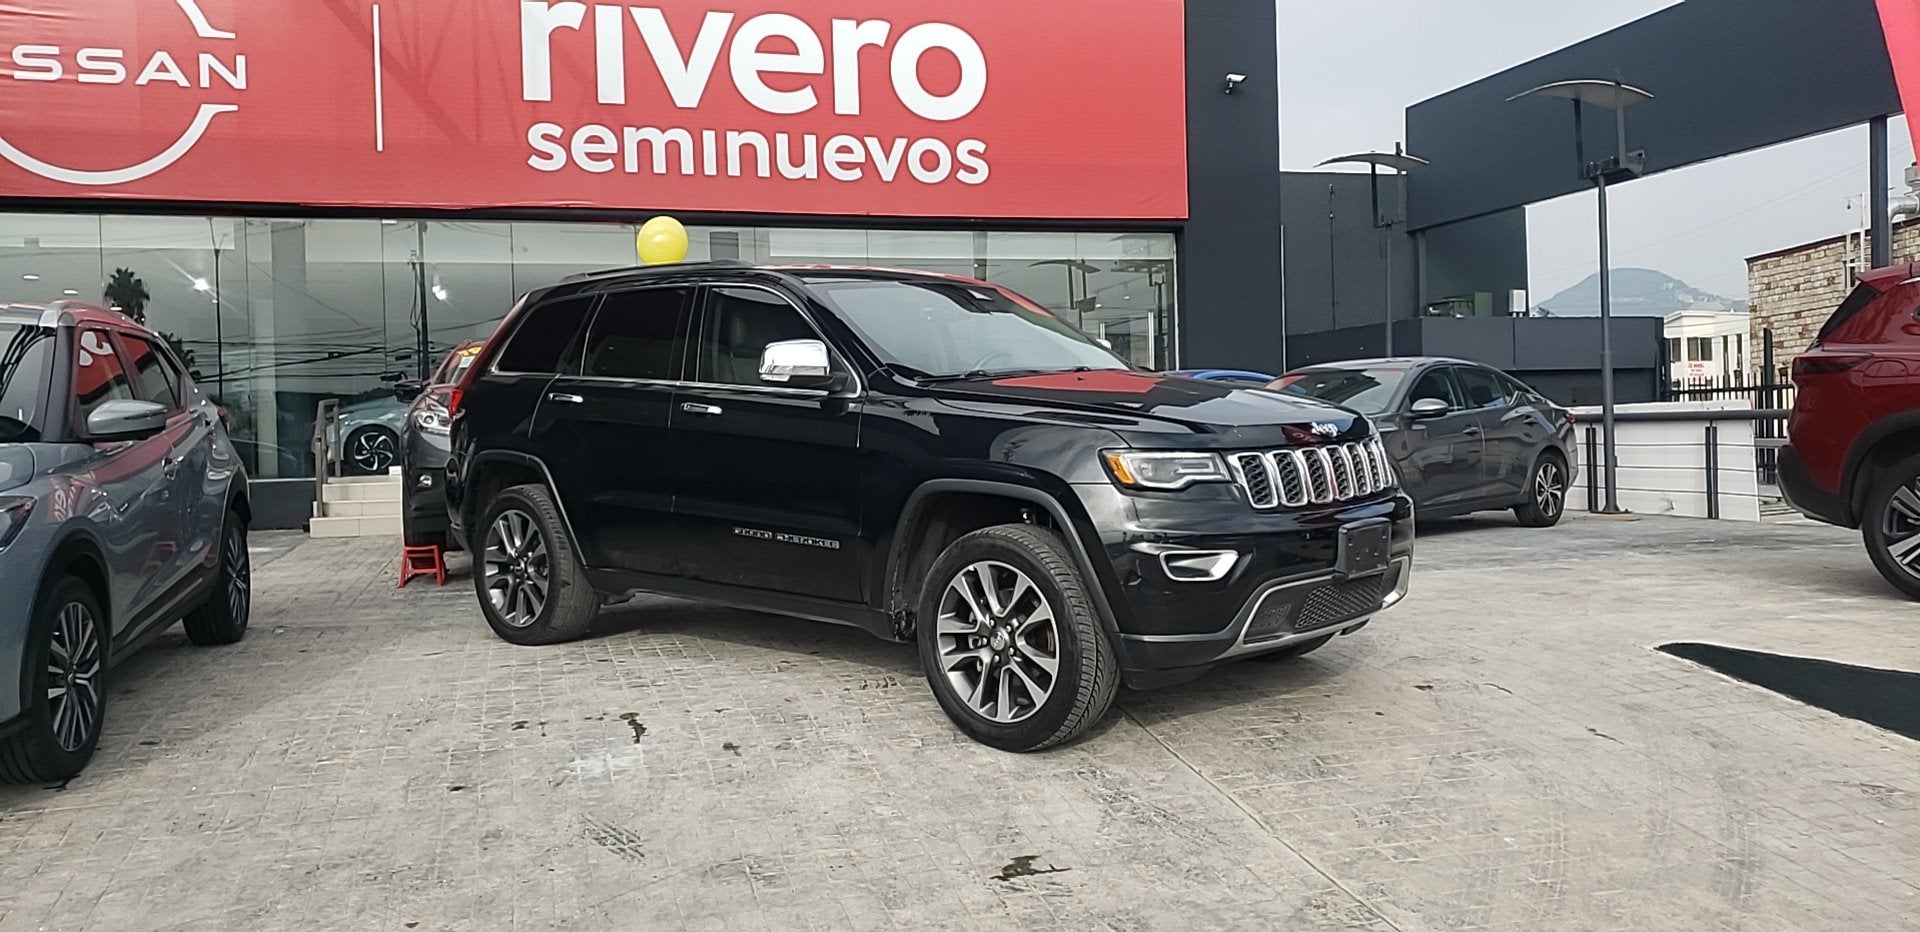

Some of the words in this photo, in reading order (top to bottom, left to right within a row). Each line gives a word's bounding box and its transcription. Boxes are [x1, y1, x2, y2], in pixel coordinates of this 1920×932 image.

[520, 0, 988, 121] rivero
[527, 122, 991, 185] seminuevos
[1311, 421, 1338, 438] Jeep
